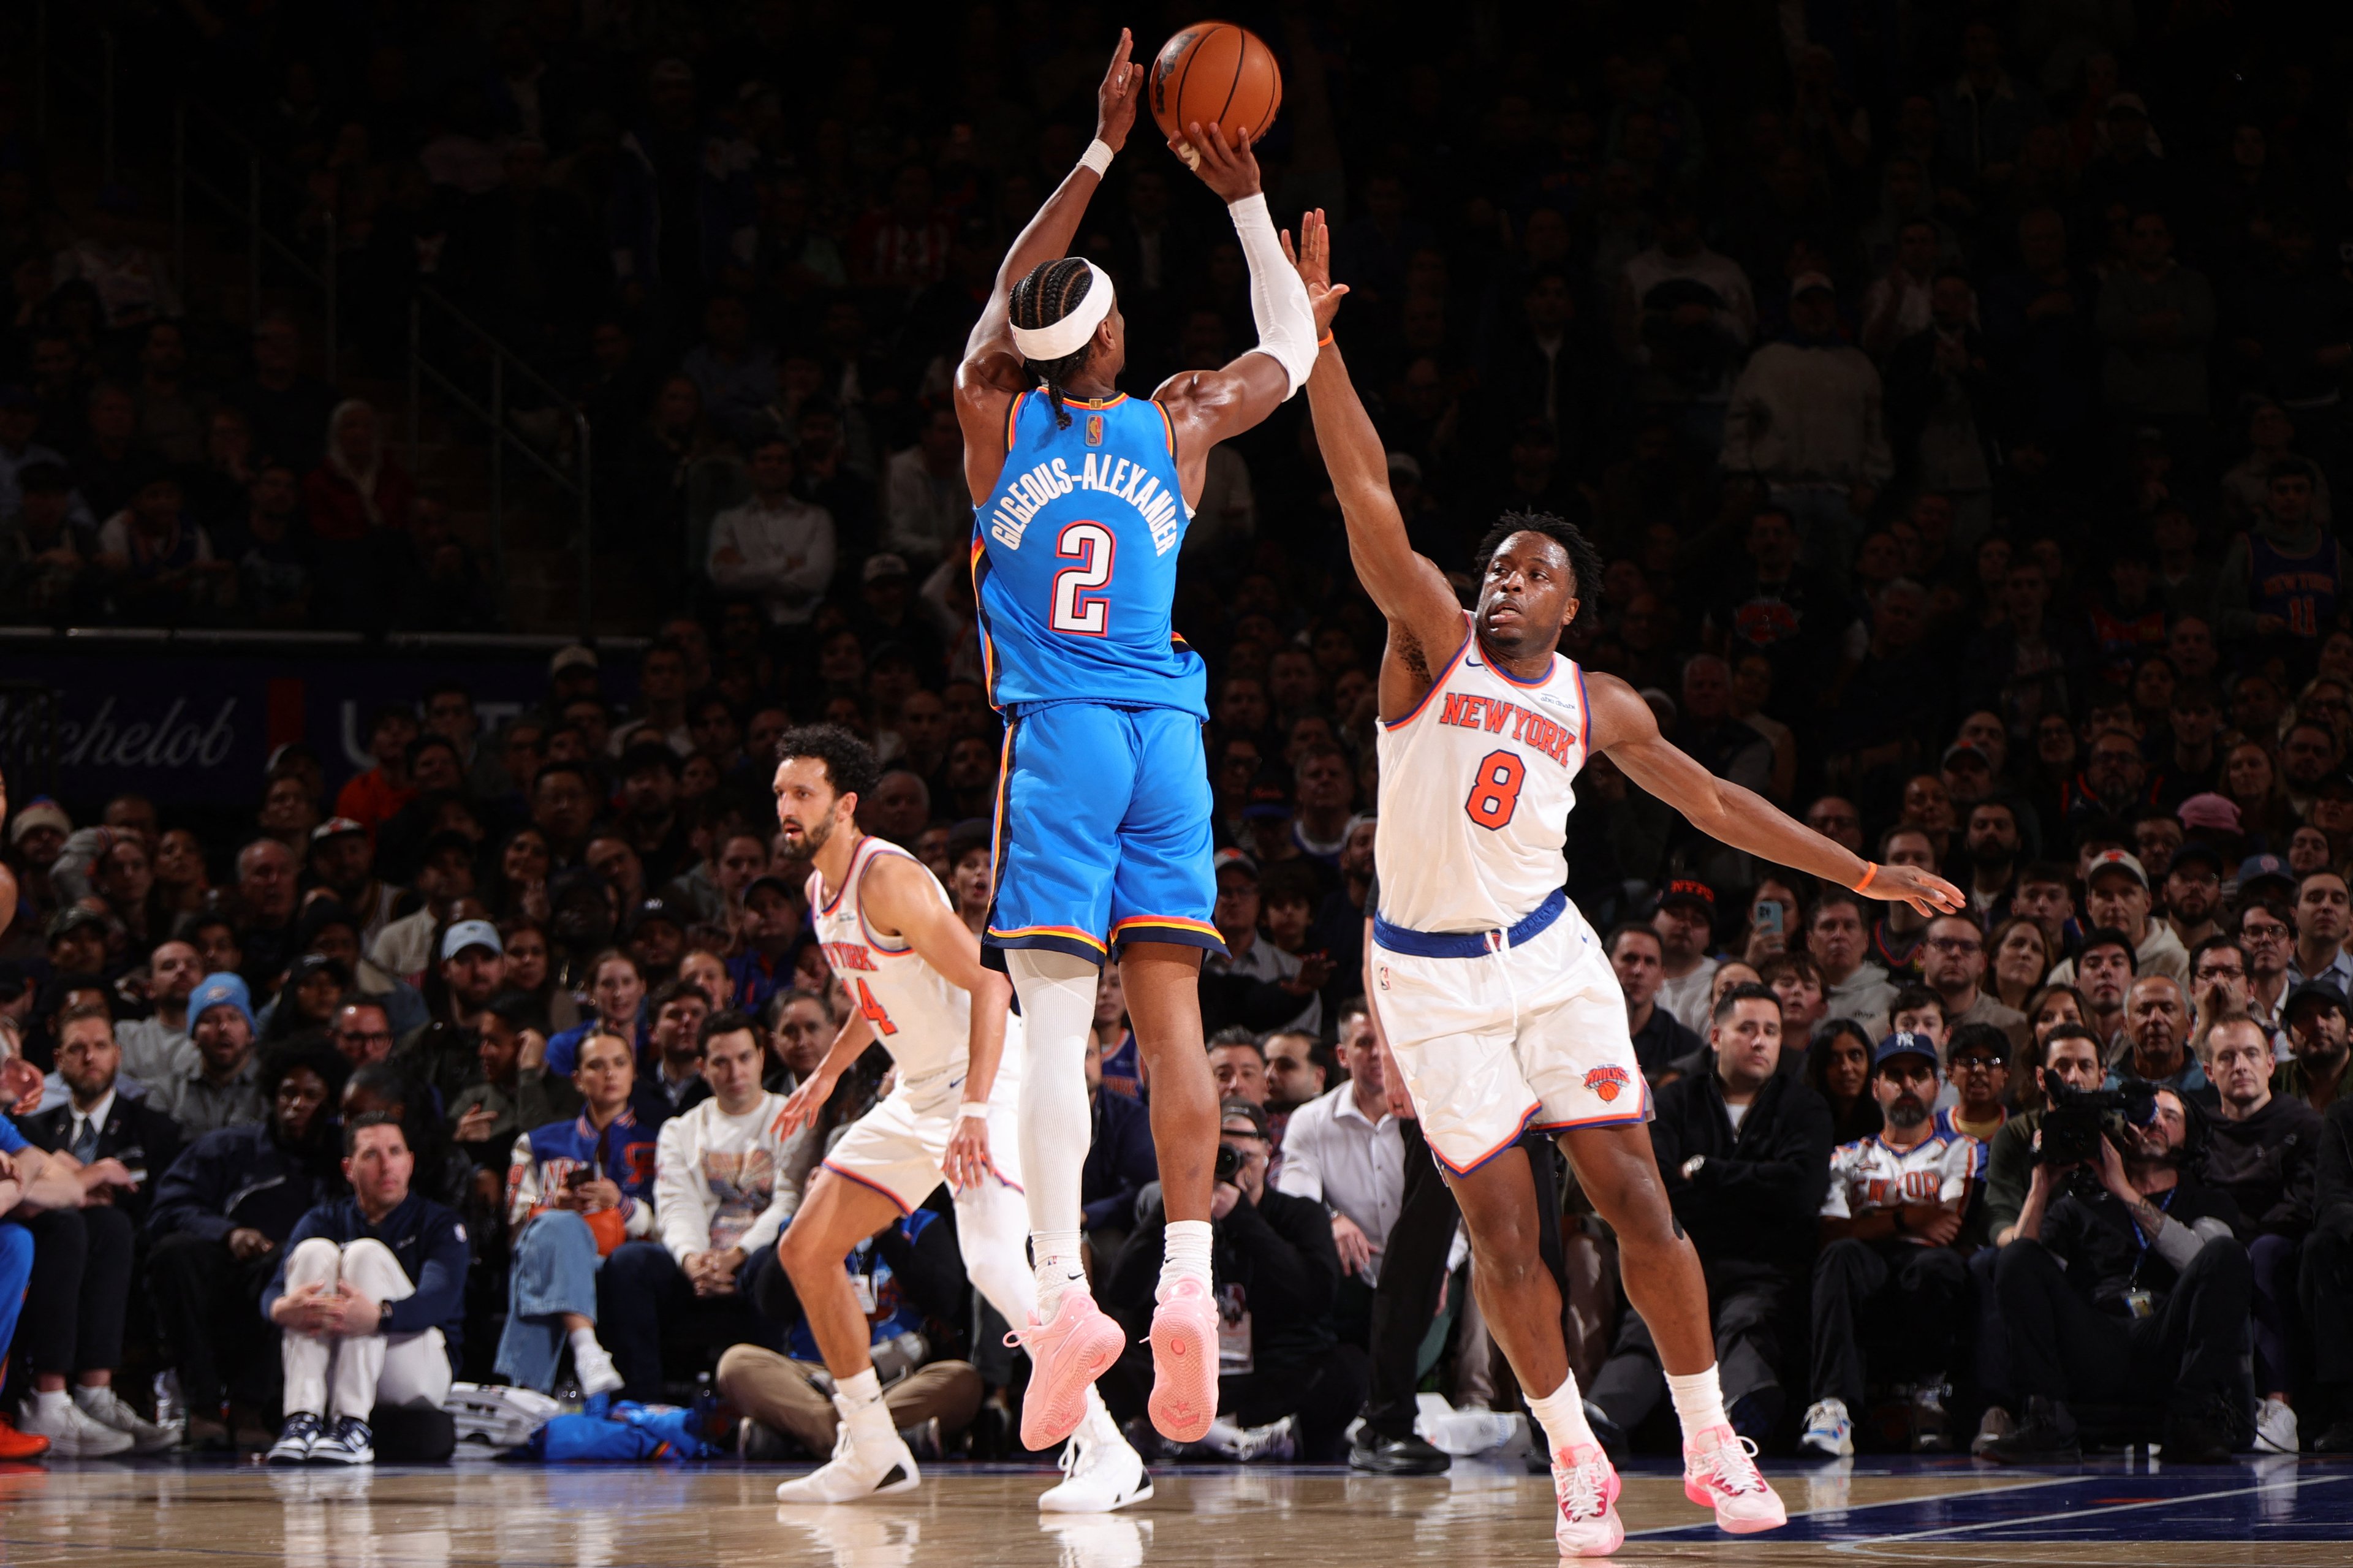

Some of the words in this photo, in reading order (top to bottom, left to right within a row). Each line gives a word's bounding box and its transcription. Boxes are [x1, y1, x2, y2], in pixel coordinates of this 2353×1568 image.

[991, 453, 1177, 556] GILGEOUS-ALEXANDER
[1050, 520, 1116, 637] 2
[2289, 594, 2317, 637] 11
[1439, 692, 1514, 735] NEW
[1510, 705, 1578, 769] YORK
[1464, 749, 1526, 831] 8
[1584, 1066, 1631, 1088] KNICKS
